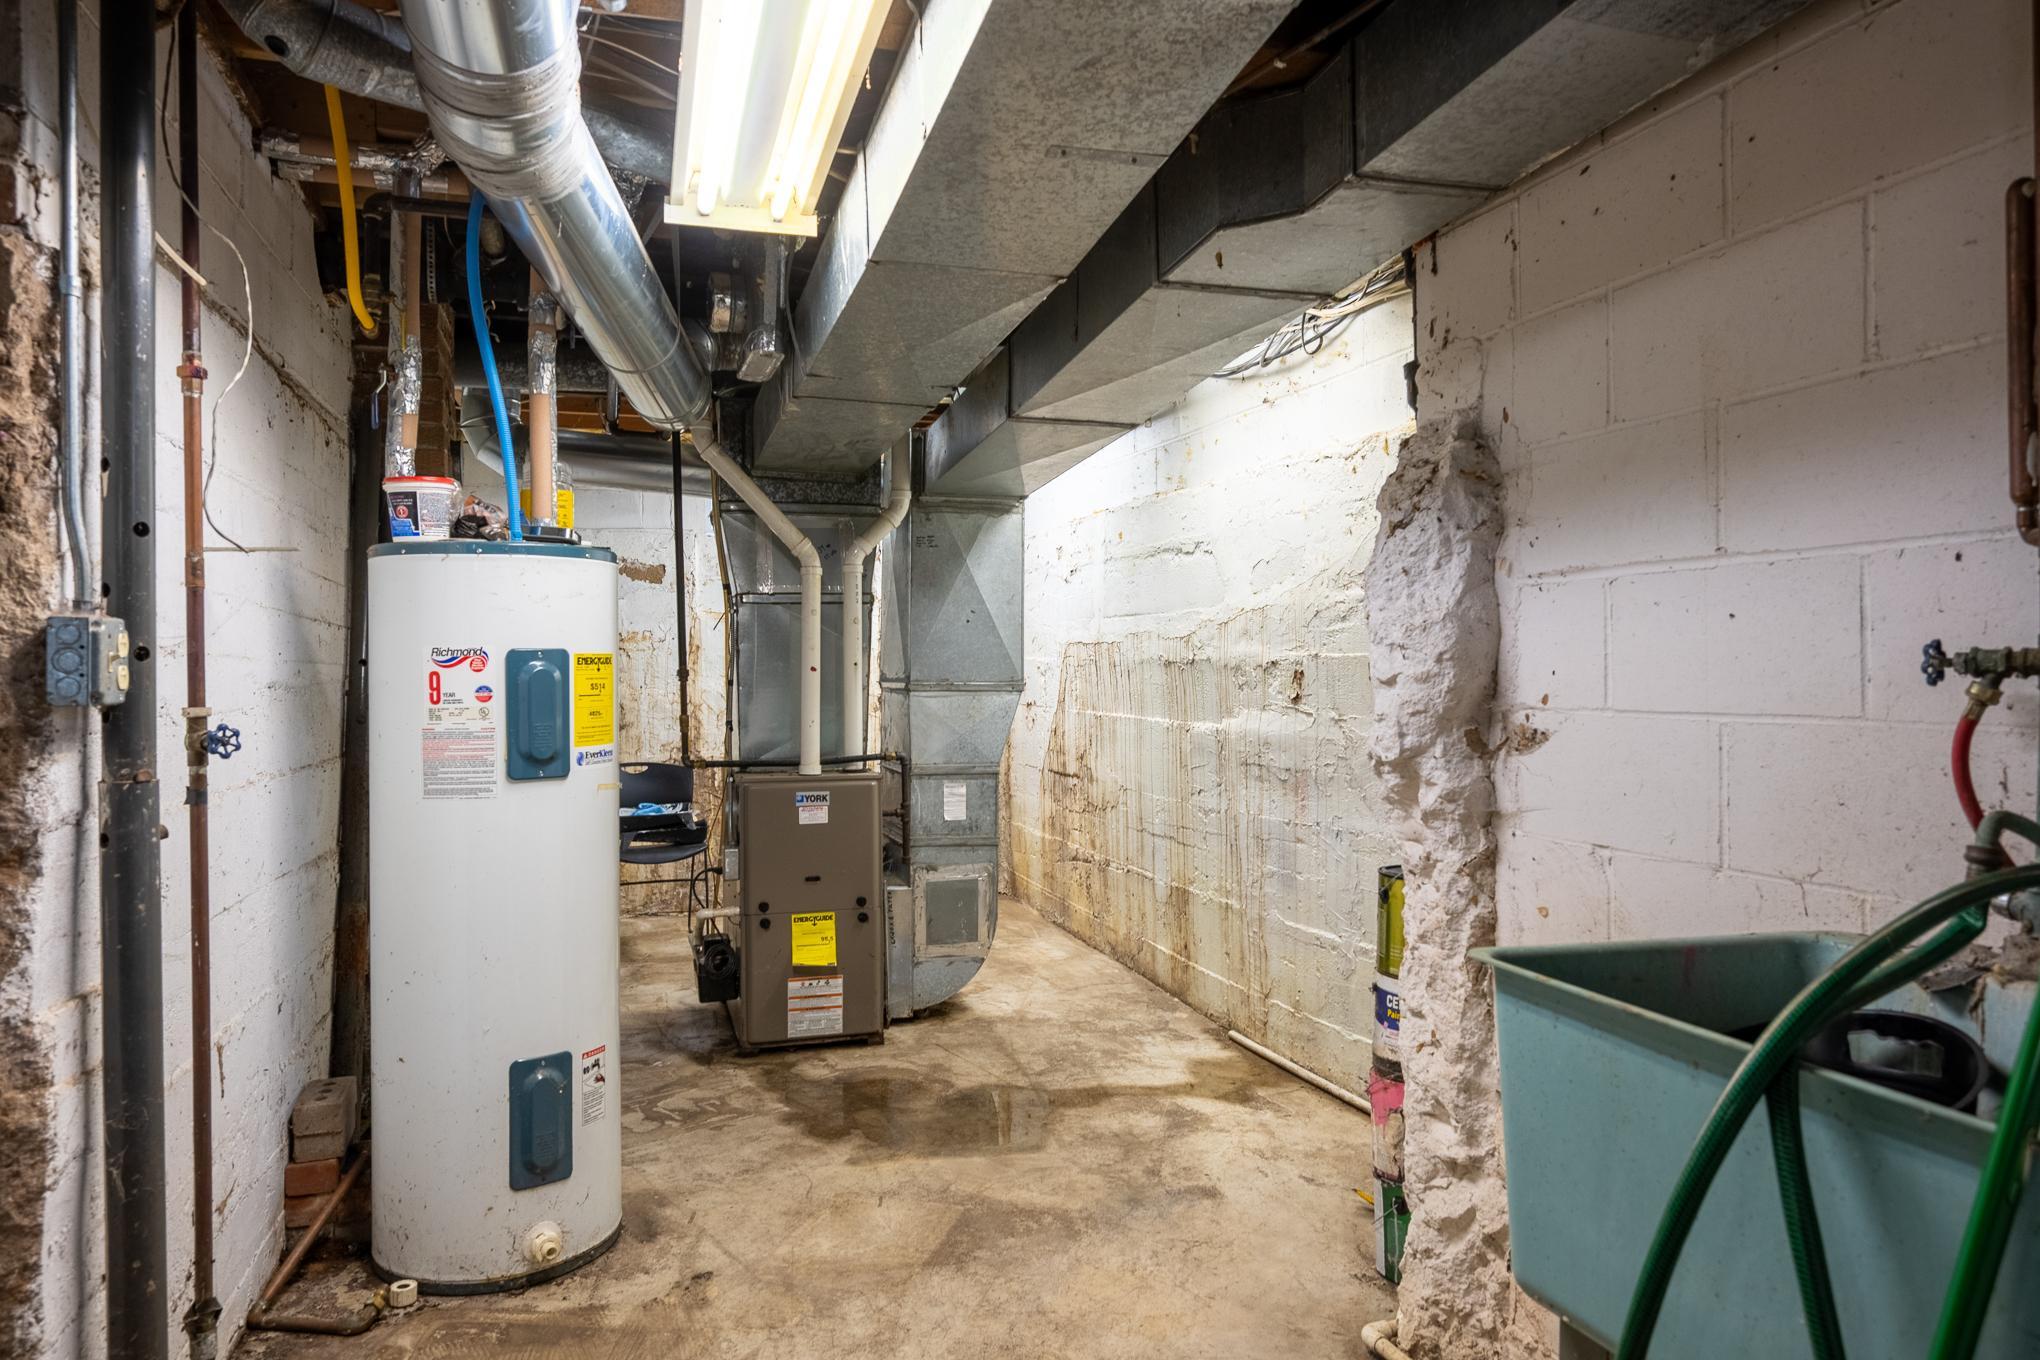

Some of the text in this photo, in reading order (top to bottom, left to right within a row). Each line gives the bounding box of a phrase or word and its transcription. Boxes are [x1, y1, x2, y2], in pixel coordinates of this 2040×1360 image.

[431, 646, 483, 657] Richmond
[429, 671, 441, 705] 9
[804, 794, 828, 803] YORK
